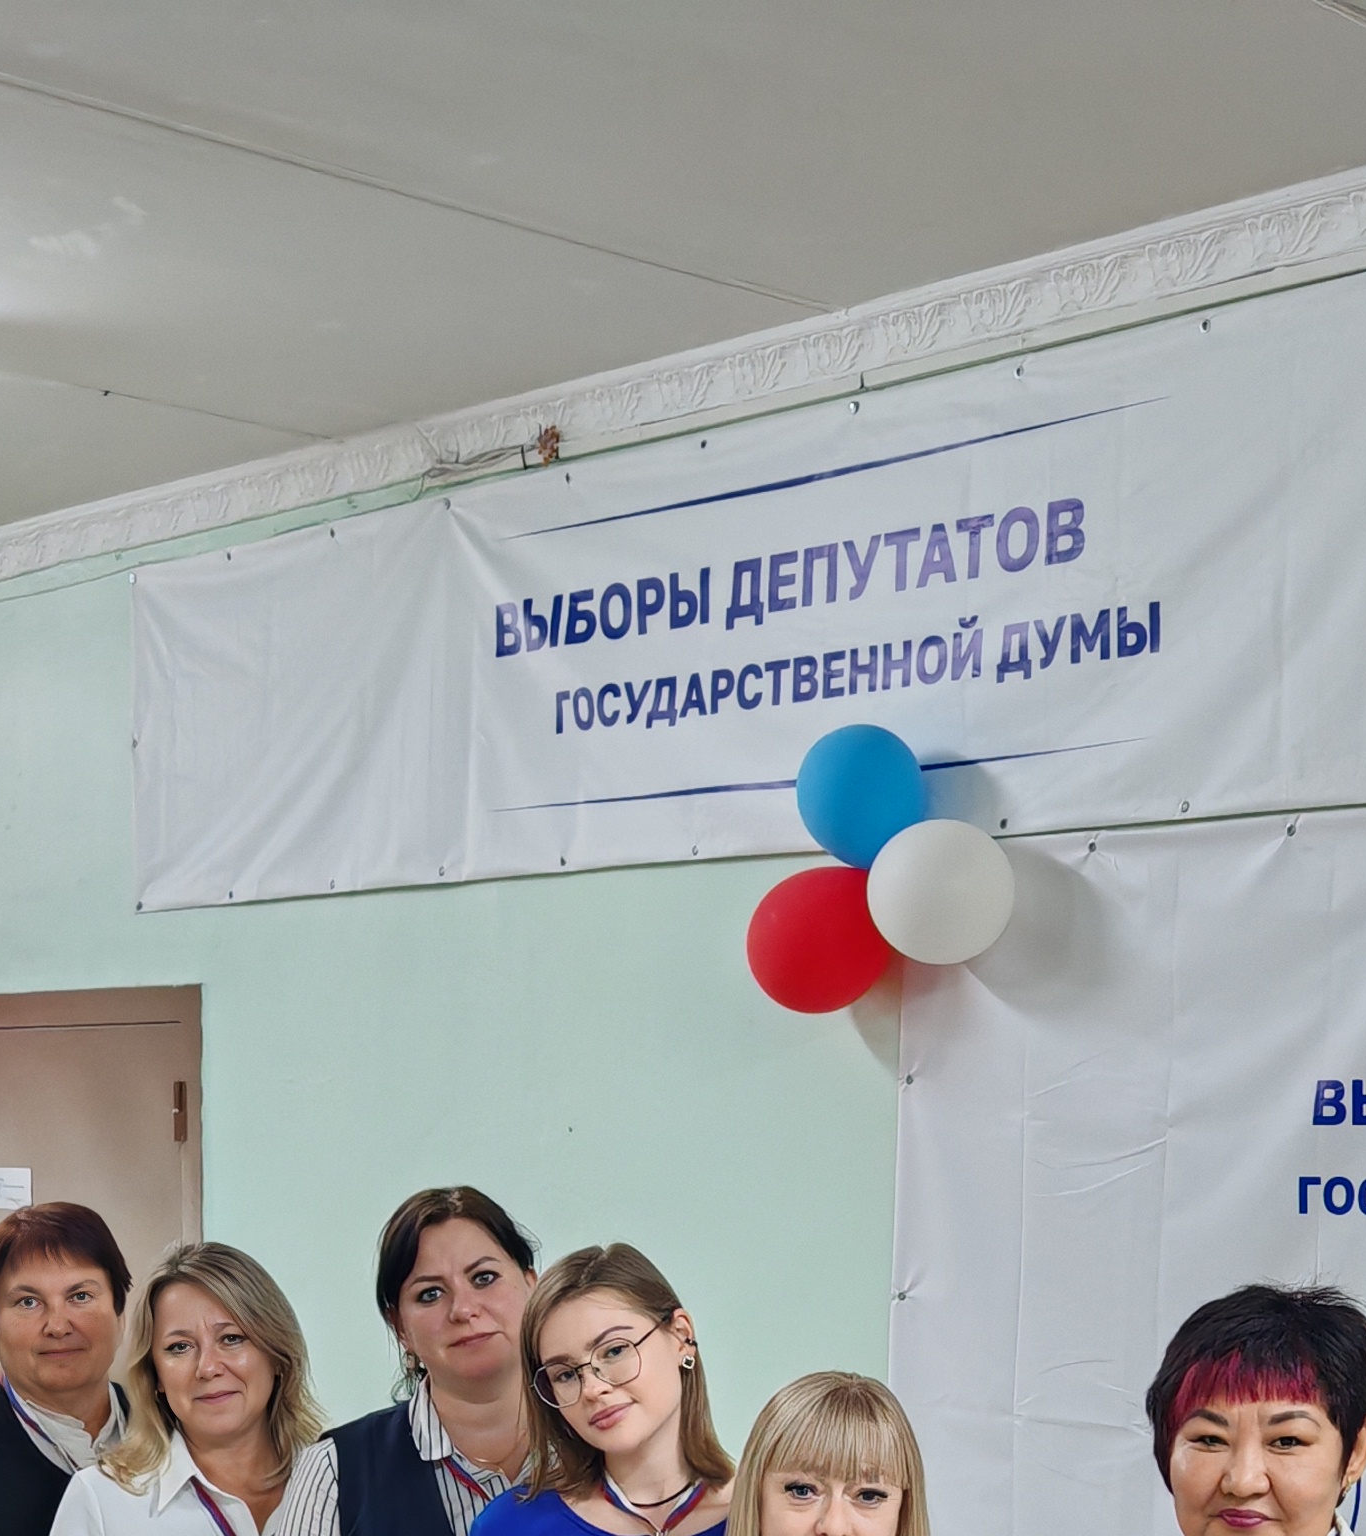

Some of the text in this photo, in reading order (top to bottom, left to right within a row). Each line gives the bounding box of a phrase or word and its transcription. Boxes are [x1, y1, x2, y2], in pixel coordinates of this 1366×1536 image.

[496, 500, 1084, 657] ВЫБОРЫ ДЕПУТАТОВ
[556, 602, 1160, 734] ГОСУДАРСТВЕННОЙ ДУМЫ
